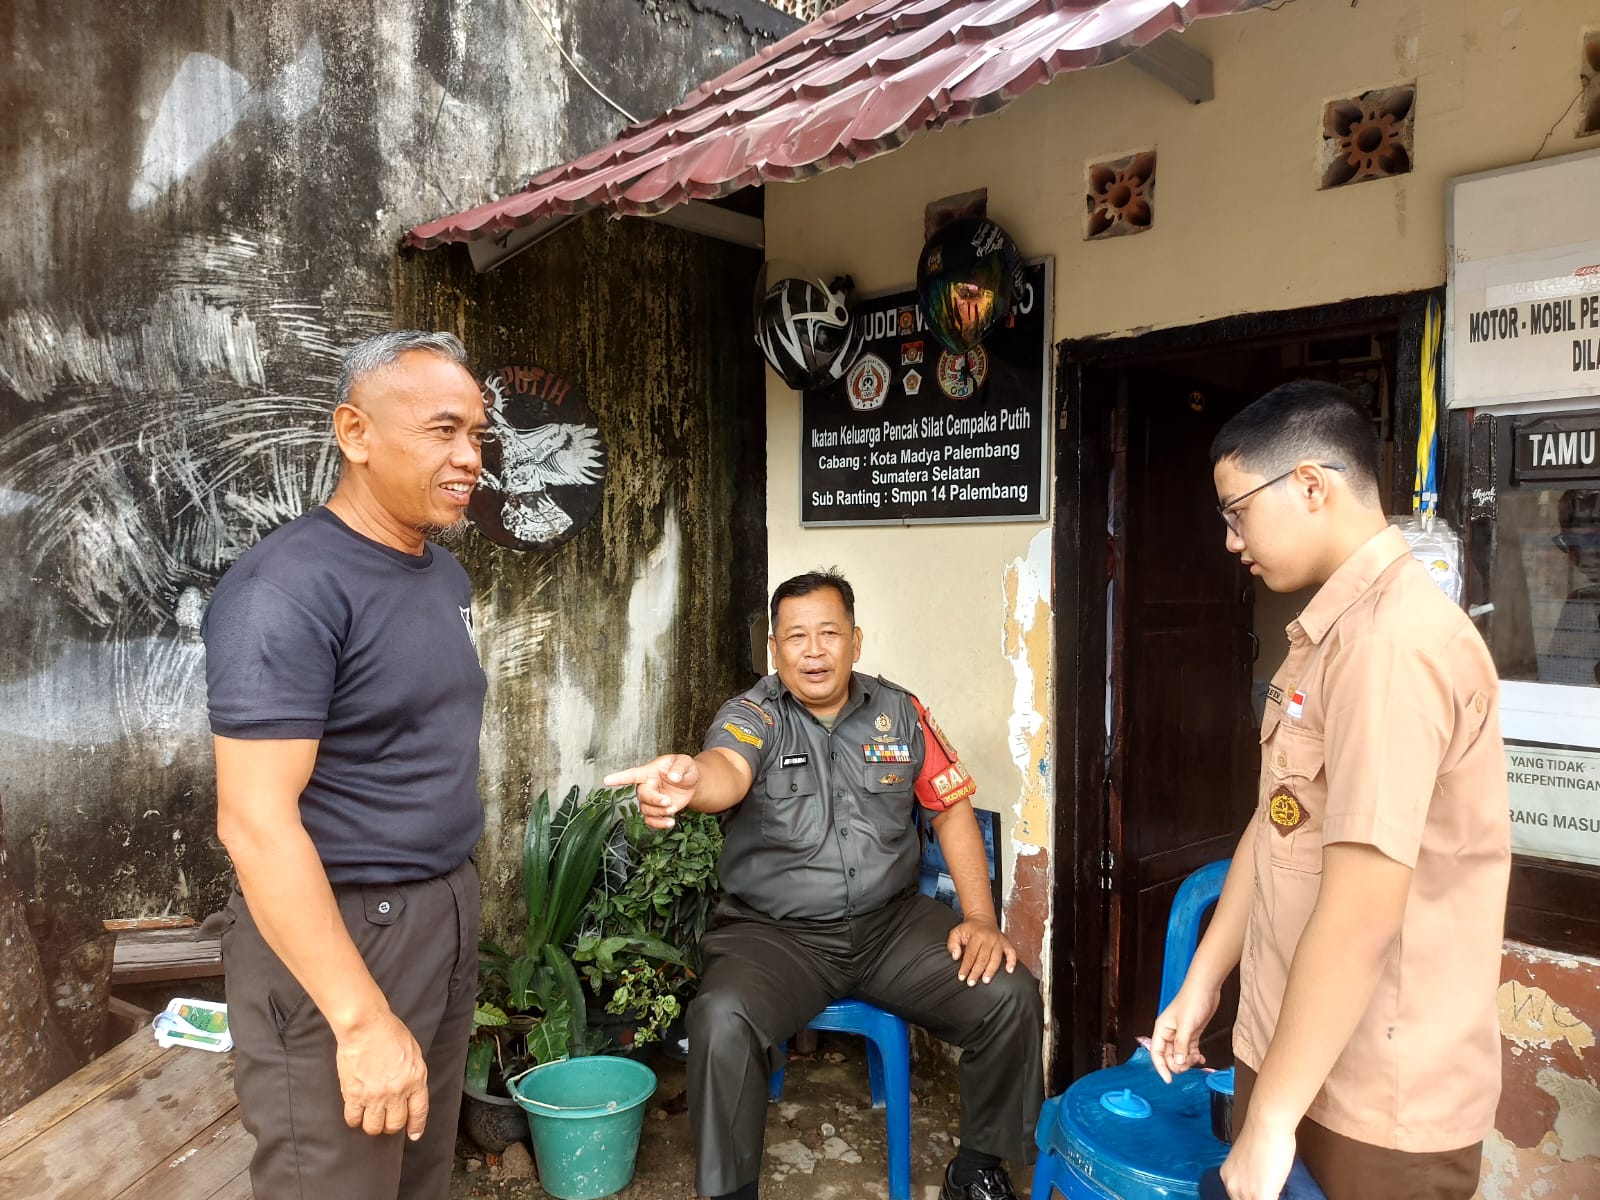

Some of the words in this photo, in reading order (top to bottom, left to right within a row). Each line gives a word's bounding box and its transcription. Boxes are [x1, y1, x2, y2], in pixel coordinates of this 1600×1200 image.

[1469, 308, 1518, 344] MOTOR
[1530, 299, 1576, 335] MOBIL
[1580, 296, 1600, 330] PE
[499, 365, 571, 407] PUTIH
[811, 428, 838, 448] Ikatan
[840, 424, 881, 448] Keluarga
[883, 418, 919, 442] Pencak
[921, 416, 944, 438] Silat
[946, 410, 997, 440] Cempaka
[1000, 406, 1031, 431] Putih
[818, 455, 860, 471] Cabang
[870, 451, 897, 466] Kota
[900, 447, 941, 466] Madya
[944, 442, 1020, 460] Palembang
[1528, 430, 1596, 467] TAMU
[871, 468, 929, 485] Sumatera
[932, 465, 980, 481] Selatan
[811, 490, 833, 506] Sub
[836, 488, 881, 508] Ranting
[891, 487, 927, 507] Smpn
[931, 485, 946, 501] 14
[950, 482, 1028, 502] Palembang
[1510, 755, 1544, 769] YANG
[1546, 759, 1585, 773] TIDAK
[945, 781, 977, 803] KORA
[1507, 771, 1600, 791] RKEPENTINGAN
[1508, 809, 1548, 826] RANG
[1552, 814, 1600, 833] MASU
